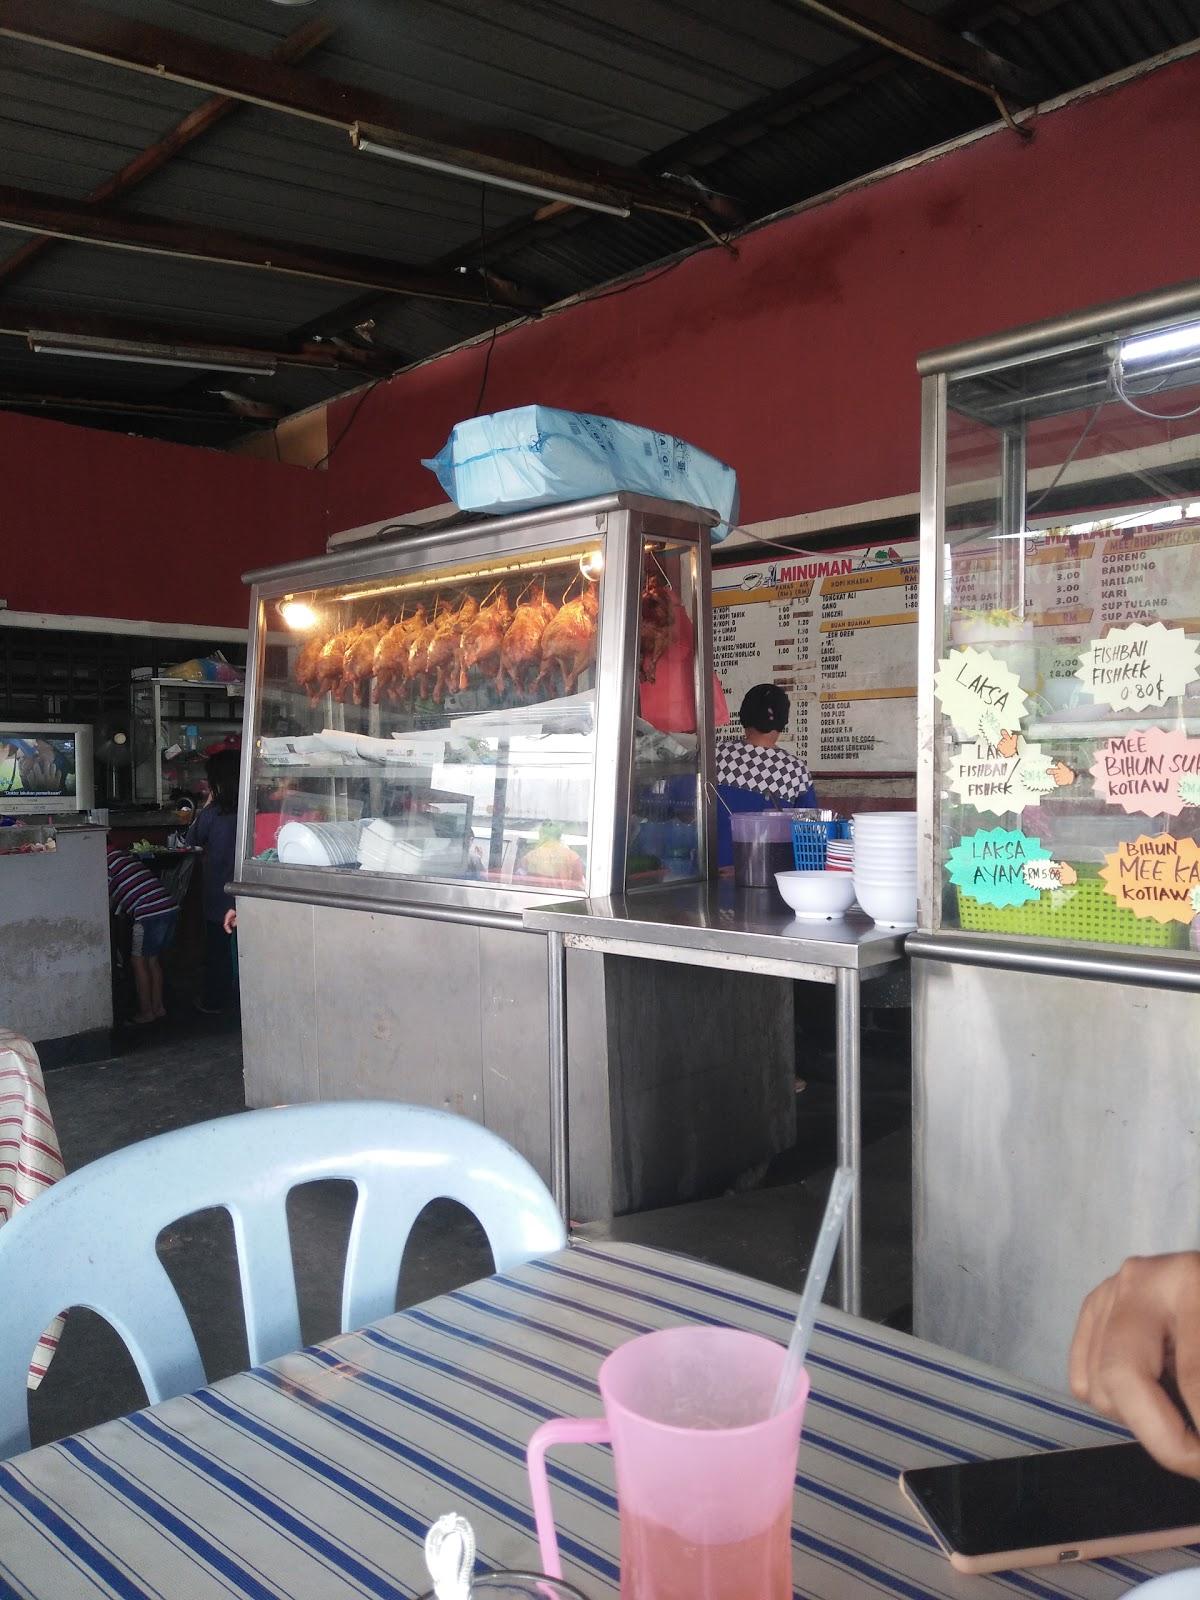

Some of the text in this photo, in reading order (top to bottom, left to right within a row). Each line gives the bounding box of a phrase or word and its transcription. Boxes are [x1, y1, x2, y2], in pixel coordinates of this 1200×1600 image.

[1102, 551, 1147, 563] GORENG
[780, 559, 853, 582] MINUMAN
[1056, 571, 1080, 581] 3.00
[1101, 561, 1156, 575] BANDUNG
[1056, 584, 1080, 593] 3.00
[1101, 575, 1144, 587] HAILAM
[1056, 595, 1079, 605] 3.00
[1101, 589, 1127, 599] KARI
[1101, 598, 1168, 611] SUP TULANG
[1101, 611, 1122, 621] SUP
[821, 655, 842, 664] CARROT
[1093, 660, 1151, 685] FISHKEK
[956, 662, 1010, 712] LAKSA
[821, 702, 851, 711] COCA COLA
[1111, 737, 1147, 754] MEE
[1105, 754, 1165, 776] BIHUN
[1108, 778, 1169, 796] KOTIAW
[973, 840, 1026, 860] LAKSA
[1126, 841, 1177, 857] BIHUN
[974, 863, 1025, 886] AYAM
[1027, 867, 1040, 880] RM
[1120, 856, 1167, 881] MEE
[1122, 884, 1190, 901] KOTIAW
